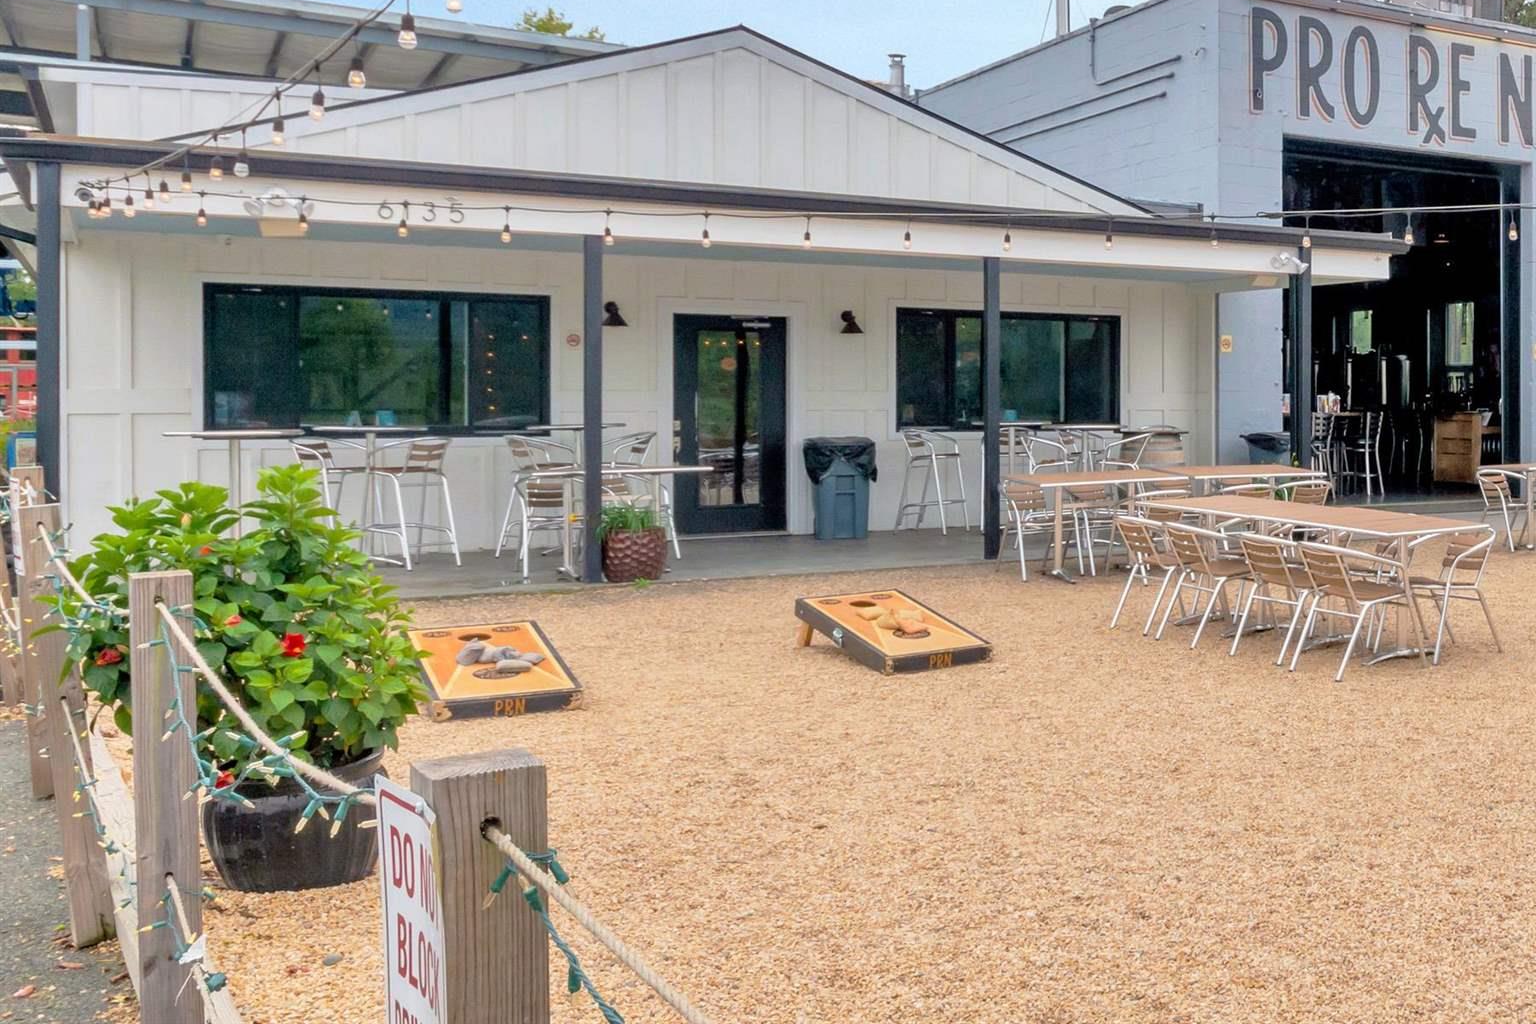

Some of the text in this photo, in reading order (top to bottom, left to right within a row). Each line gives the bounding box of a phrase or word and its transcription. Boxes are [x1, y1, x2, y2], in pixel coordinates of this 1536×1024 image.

[1249, 6, 1380, 129] PRO
[928, 651, 953, 670] PRN
[495, 697, 527, 716] PRN
[390, 824, 415, 899] DO
[396, 912, 440, 1017] BLOCK
